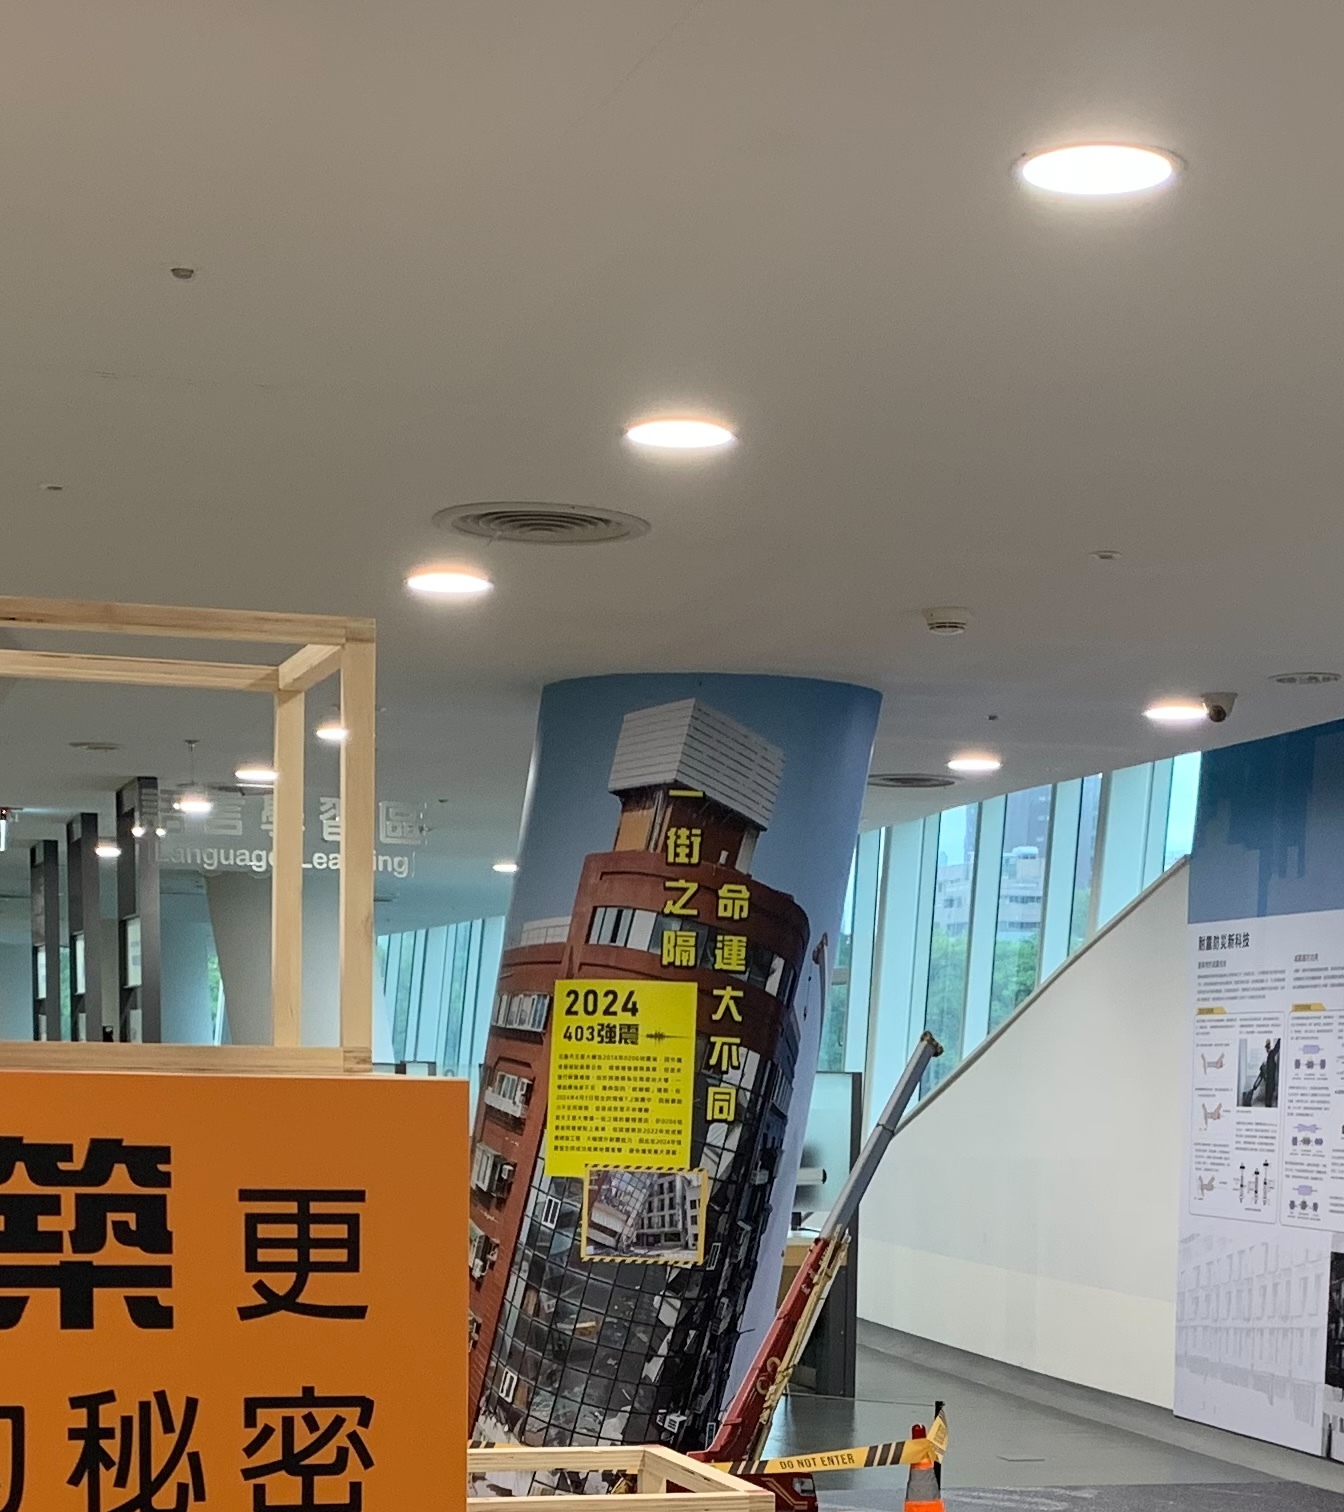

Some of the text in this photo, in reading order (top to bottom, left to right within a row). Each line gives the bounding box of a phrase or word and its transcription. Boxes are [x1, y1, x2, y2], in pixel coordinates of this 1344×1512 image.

[157, 846, 409, 878] Languag eaing
[661, 788, 704, 968] 一街之隔
[565, 989, 639, 1017] 2024
[705, 883, 750, 1123] 命運大不同
[563, 1023, 639, 1045] 403強震
[779, 1453, 855, 1470] DO NOT ENTER
